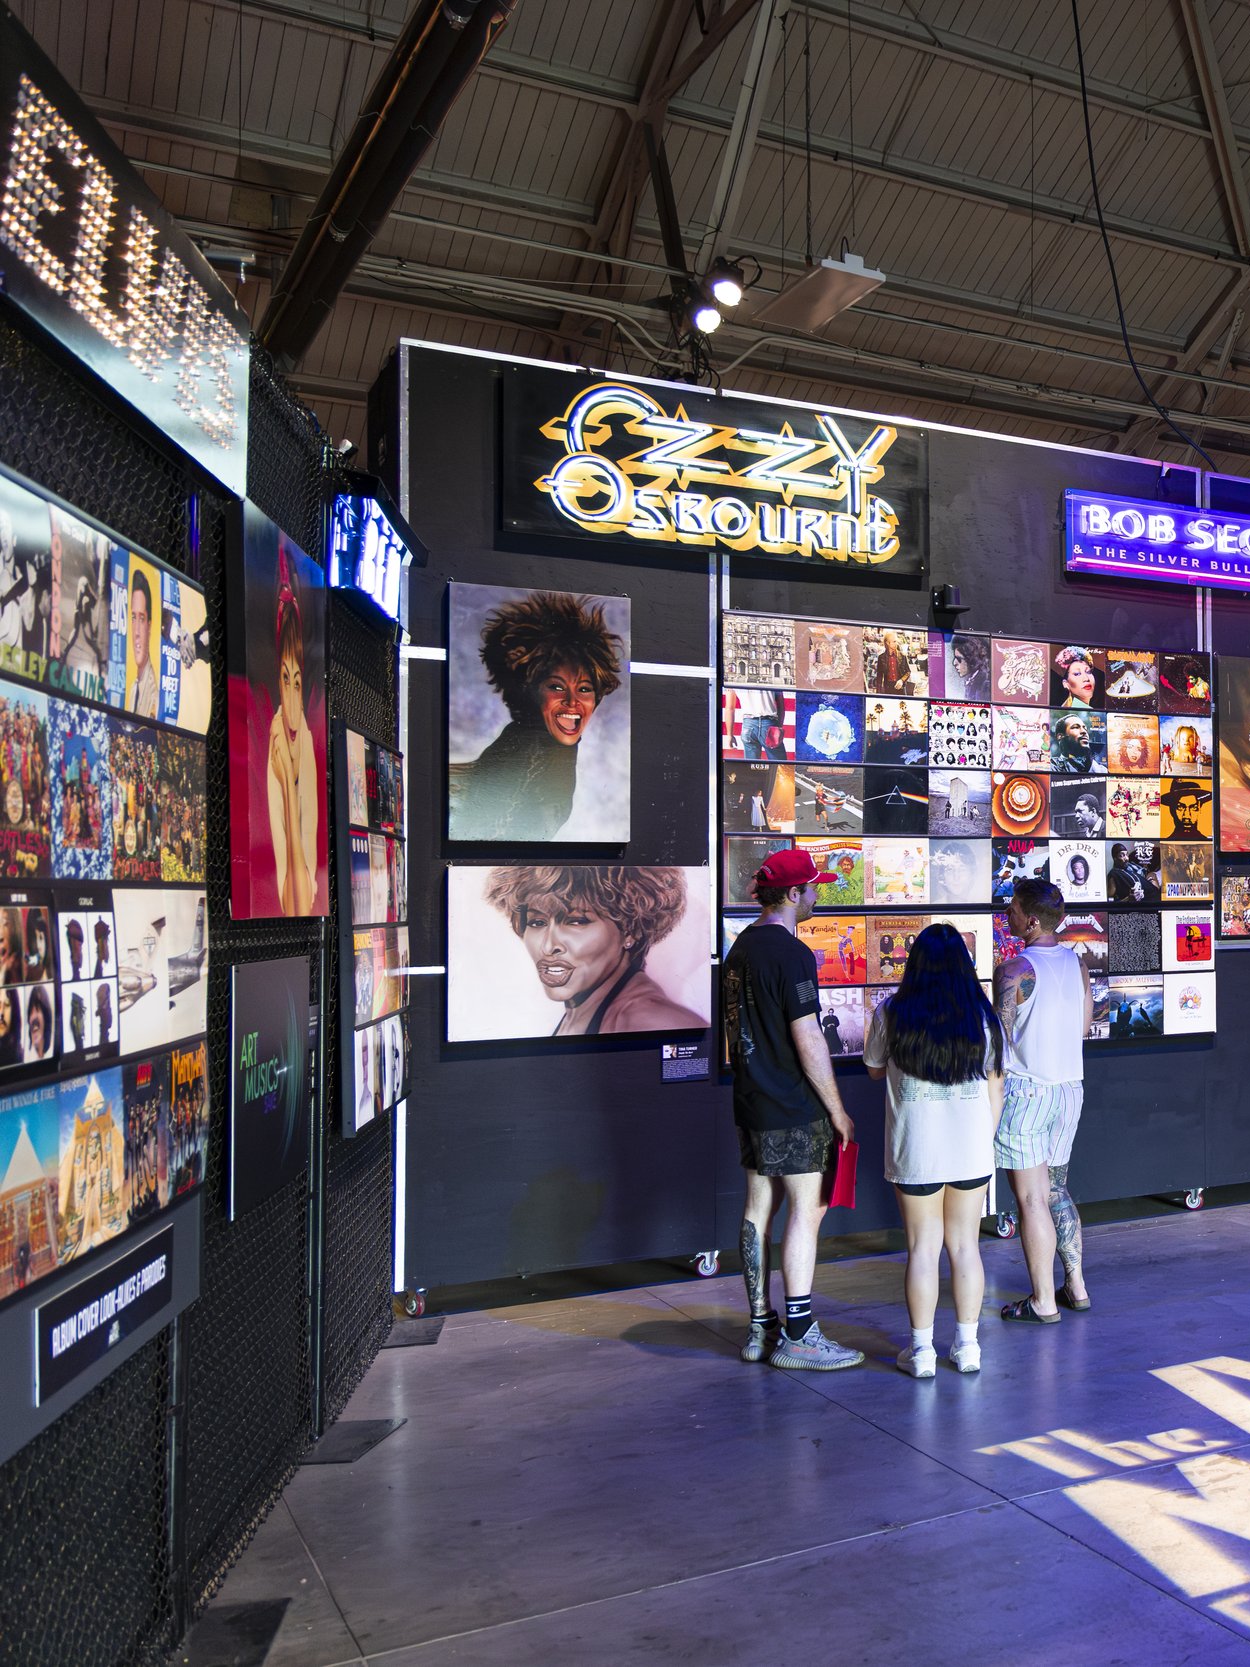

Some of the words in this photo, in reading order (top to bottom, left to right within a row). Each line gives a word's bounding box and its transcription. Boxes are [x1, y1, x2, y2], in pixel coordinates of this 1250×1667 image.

[539, 382, 898, 514] OZZY
[1081, 504, 1177, 543] BOB
[1073, 544, 1083, 555] &
[1094, 545, 1127, 560] THE
[1137, 552, 1200, 568] SILVER
[51, 658, 105, 703] CALLING
[1076, 843, 1099, 859] DRE
[818, 988, 863, 1002] ASH
[239, 1031, 259, 1071] ART
[52, 1323, 76, 1359] ALBUM
[77, 1300, 99, 1338] COVER
[140, 1254, 166, 1293] PARODIES
[972, 1427, 1240, 1479] The
